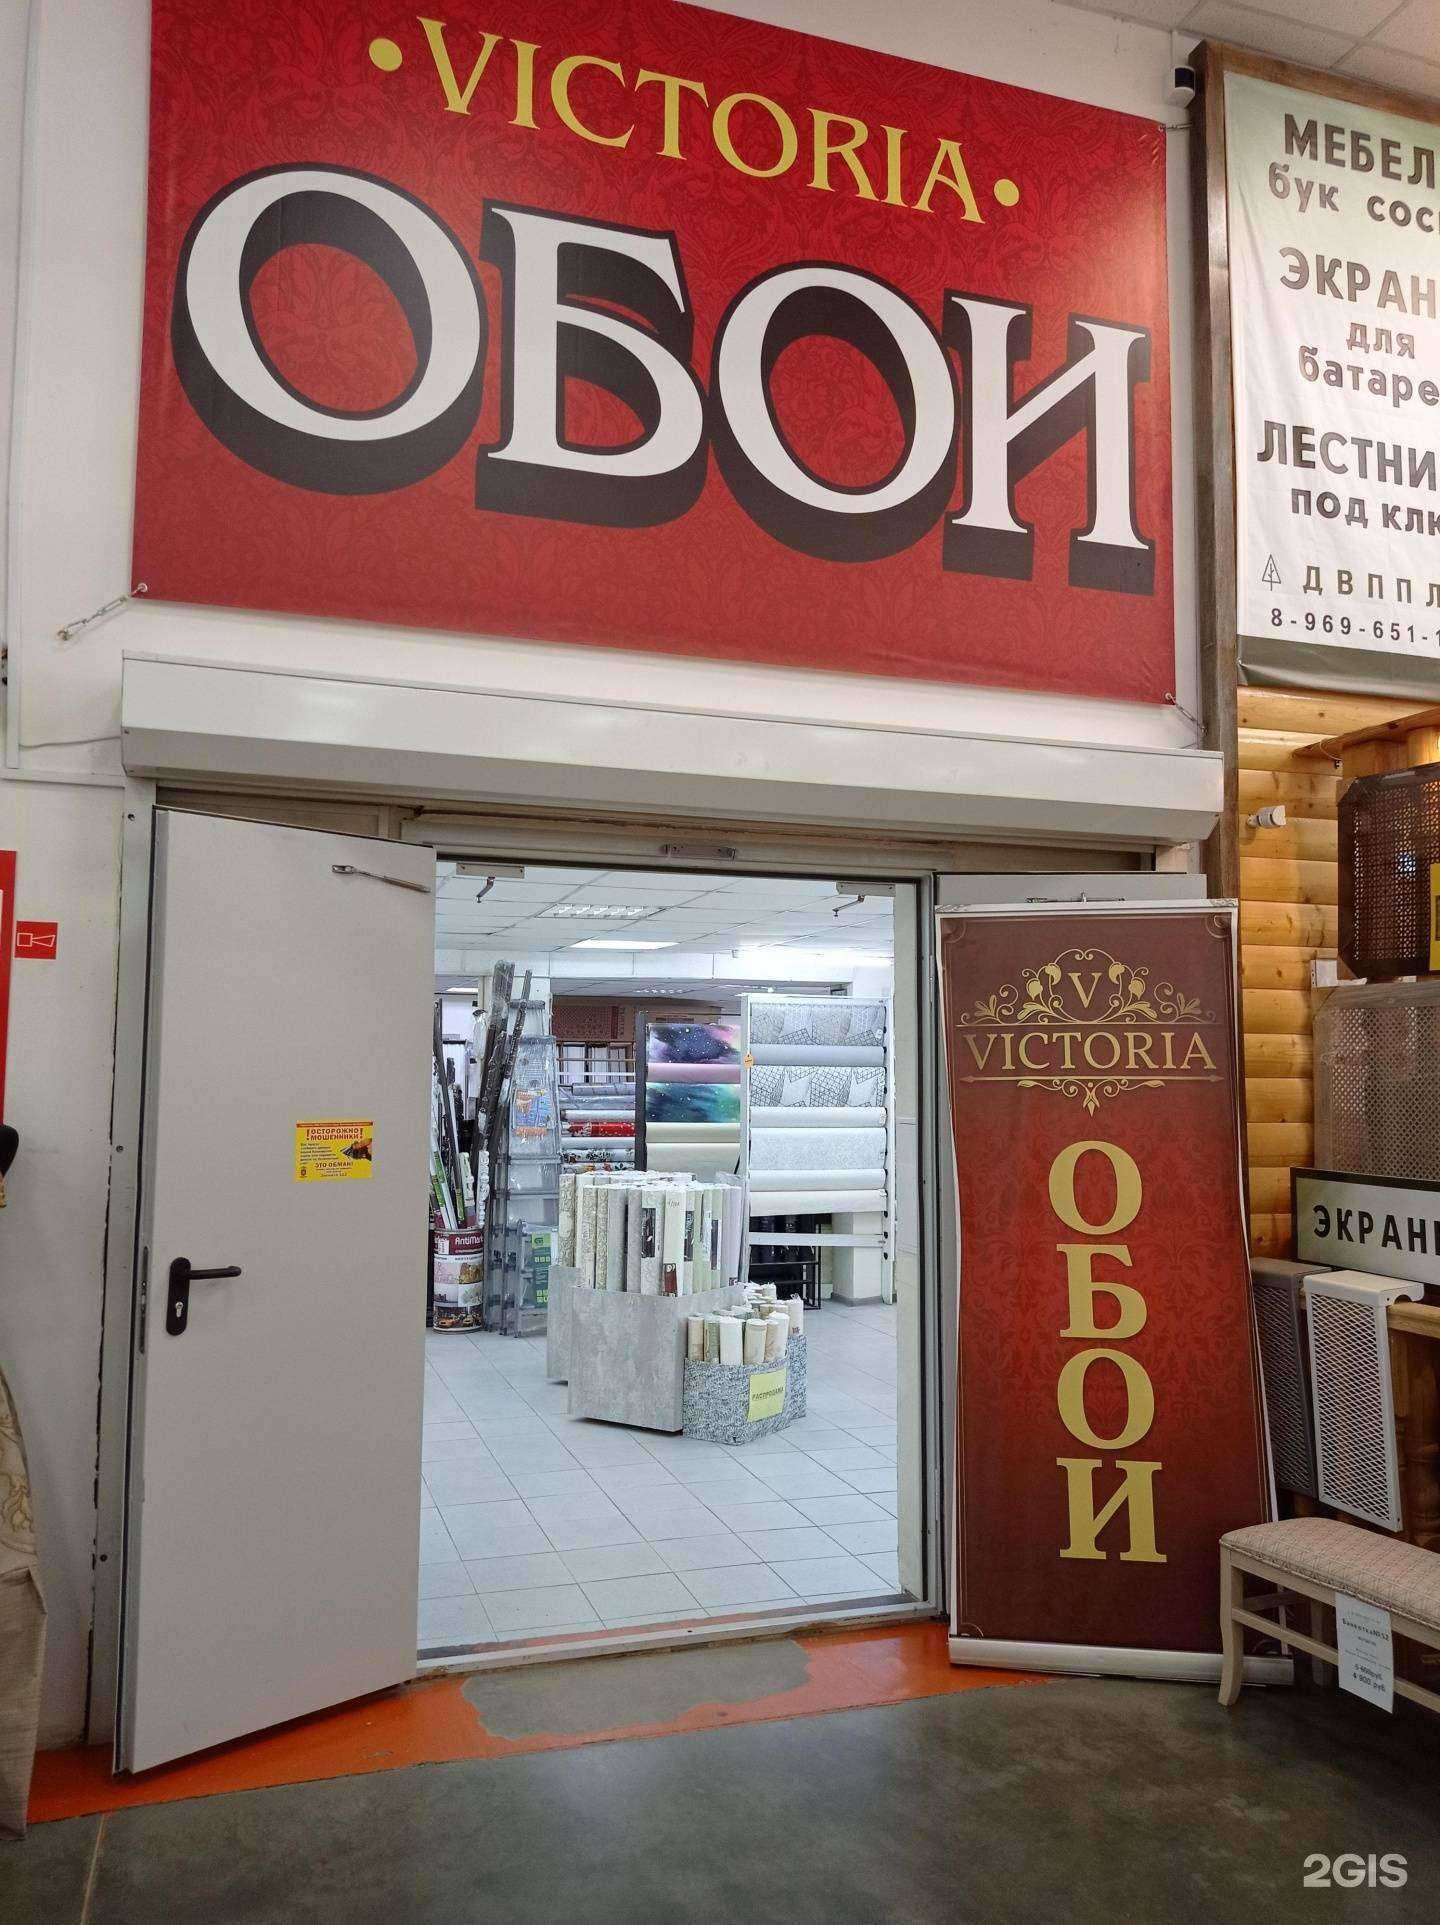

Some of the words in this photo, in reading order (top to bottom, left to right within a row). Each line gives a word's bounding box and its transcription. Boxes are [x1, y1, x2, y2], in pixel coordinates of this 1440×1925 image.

[417, 16, 985, 224] VICTORIA
[1268, 161, 1339, 213] бук
[1367, 195, 1440, 240] сос
[1279, 247, 1437, 320] ЭКРАН
[184, 168, 1151, 551] ОБОИ
[1345, 322, 1415, 359] для
[1256, 420, 1437, 491] ЛЕСТНИ
[1067, 972, 1102, 1009] V
[962, 1031, 1217, 1071] VICTORIA
[1312, 1204, 1440, 1257] ЭКРАН
[1048, 1140, 1168, 1563] ОБОИ
